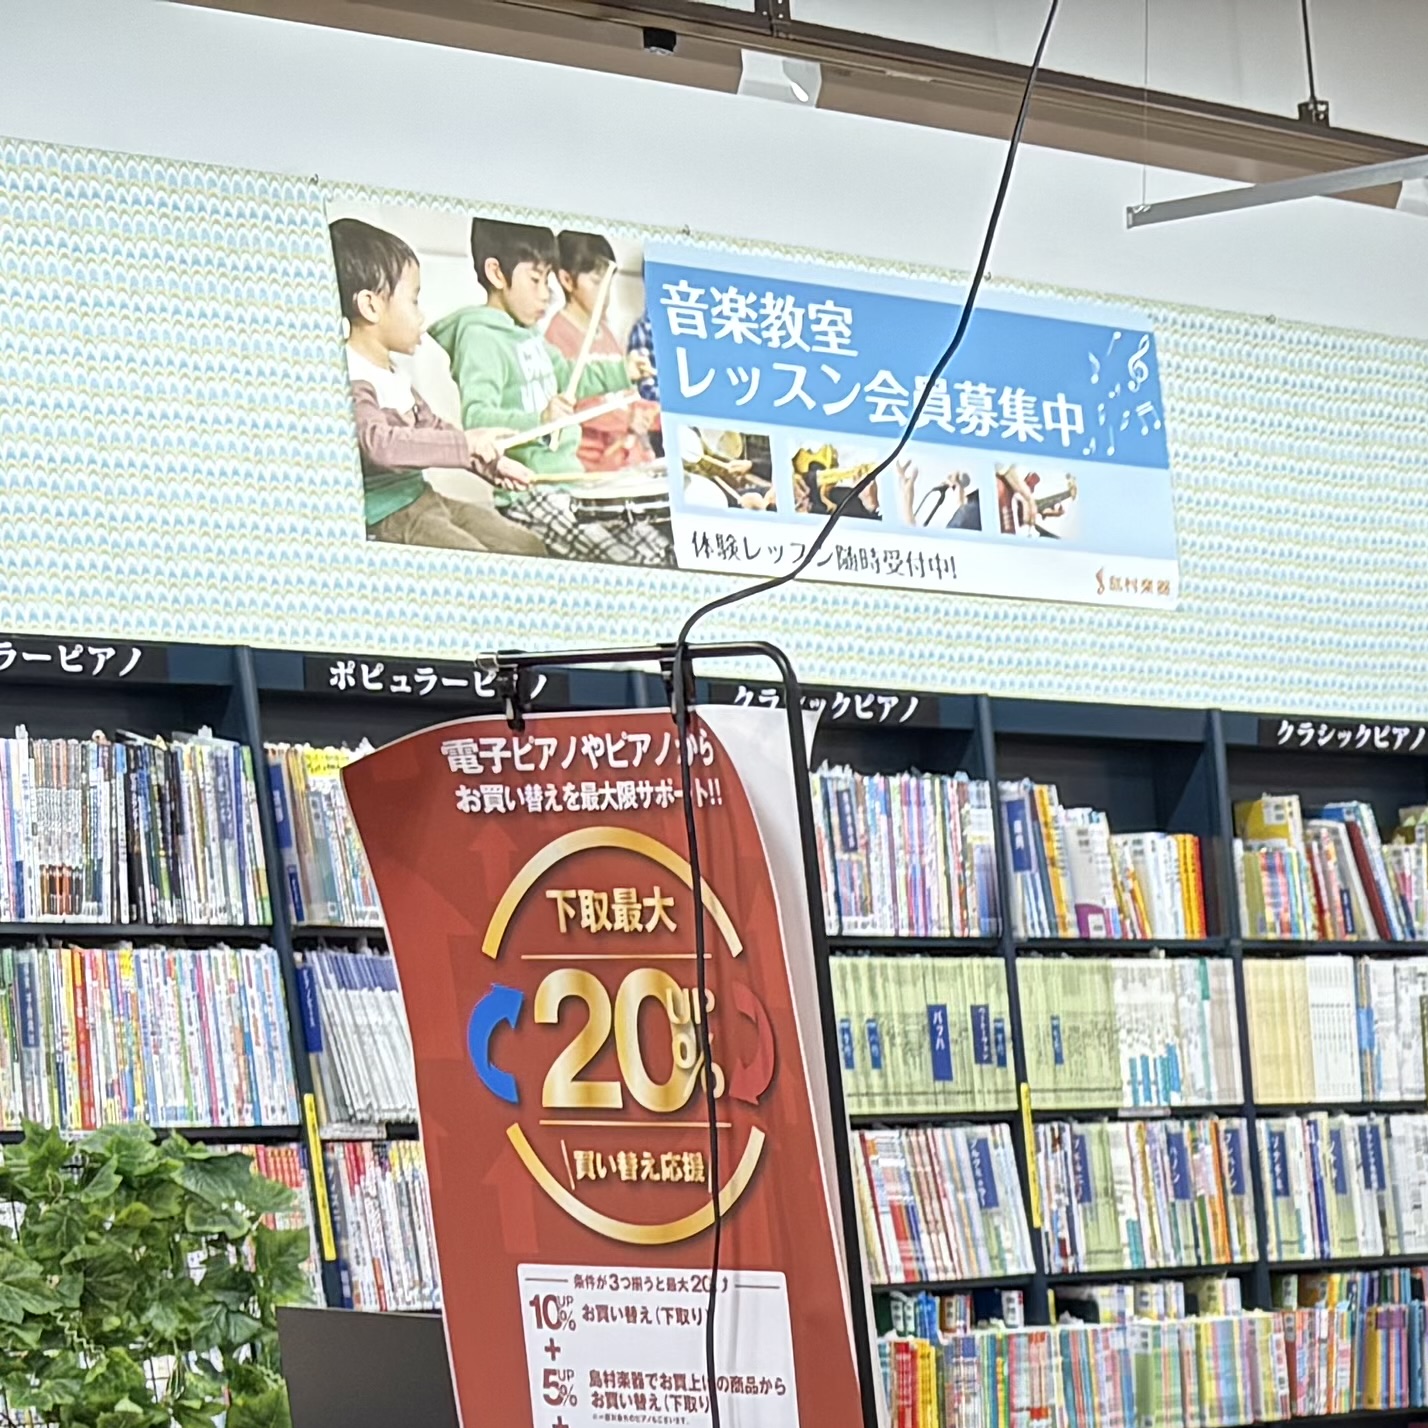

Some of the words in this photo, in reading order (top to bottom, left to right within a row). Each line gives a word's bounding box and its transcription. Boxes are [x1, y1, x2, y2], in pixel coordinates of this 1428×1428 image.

[660, 278, 858, 358] 音楽教室
[675, 352, 1085, 448] レッスン会員募集中
[330, 661, 548, 702] ポピュラーピノ
[734, 684, 920, 723] クラックピアノ
[1277, 720, 1427, 753] クラシックピアノ
[546, 886, 677, 934] 下取最大
[573, 1149, 706, 1184] 買い替え応援
